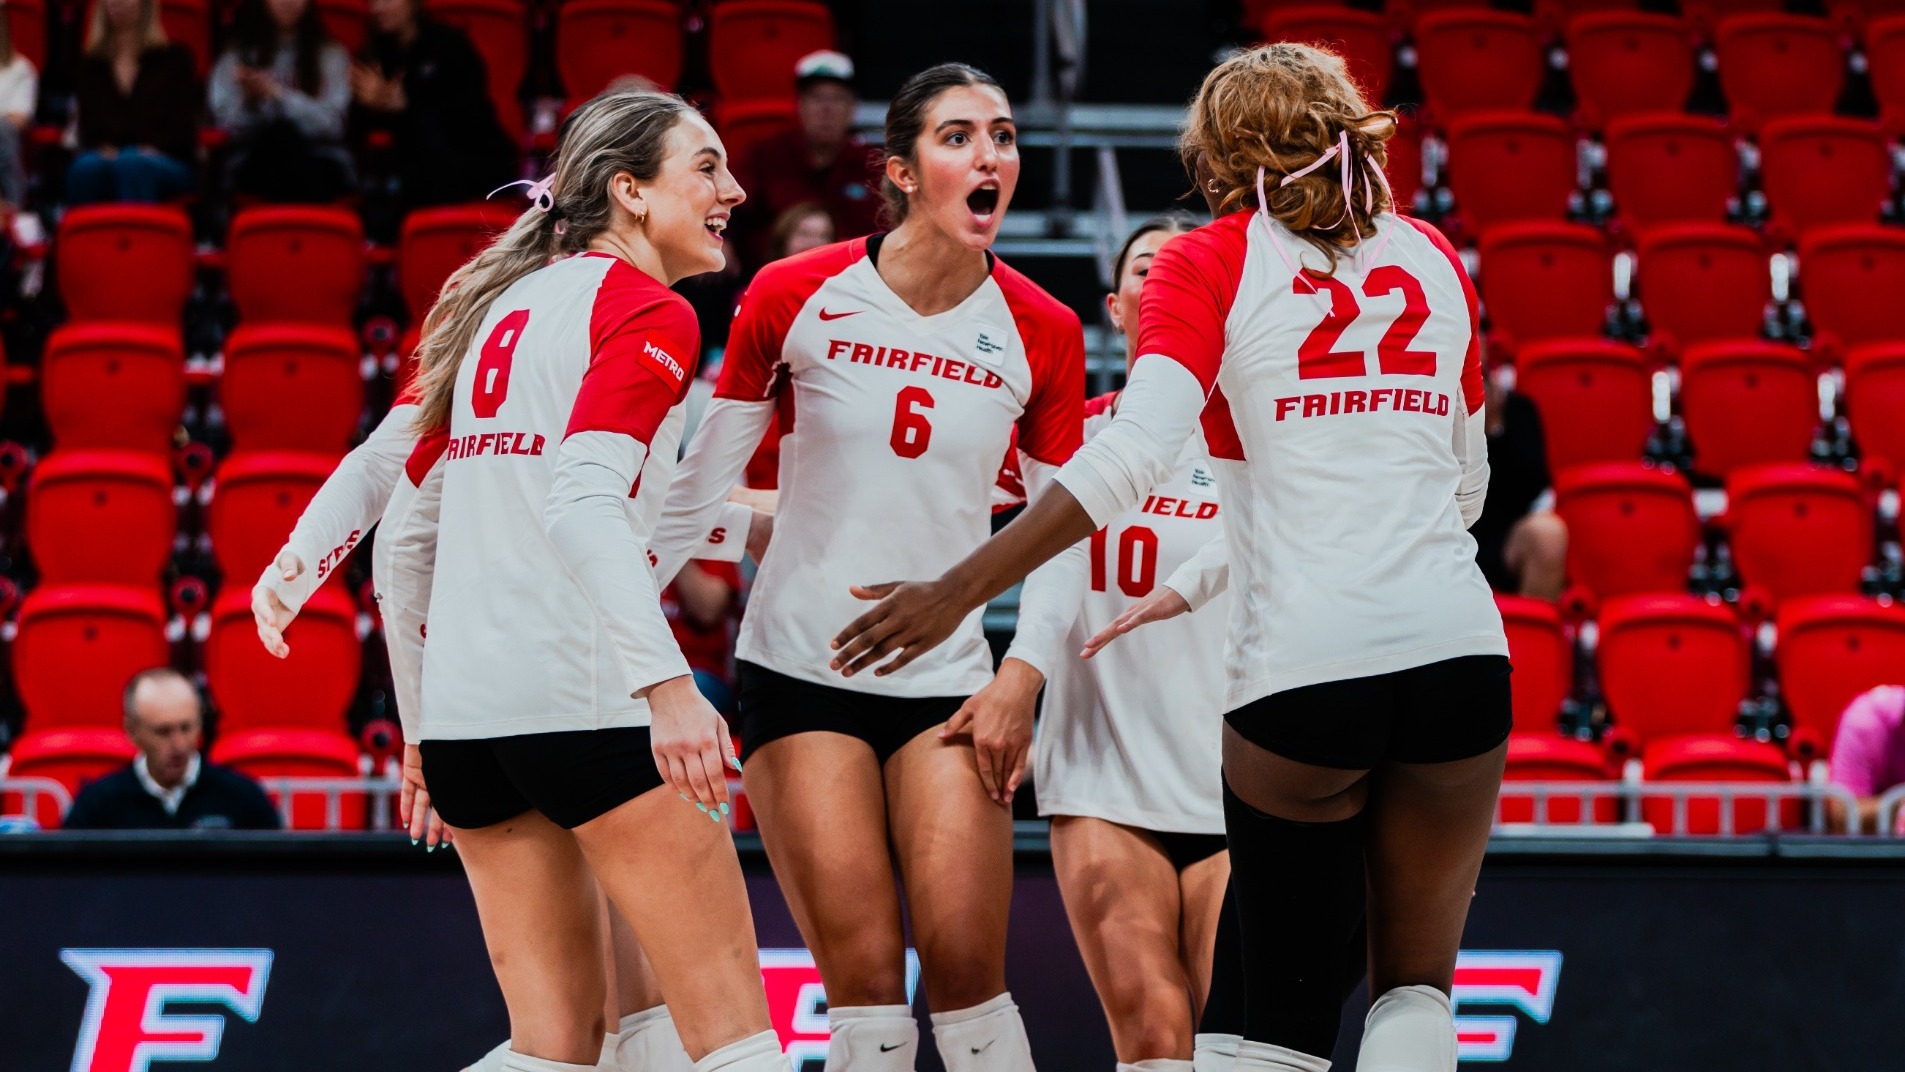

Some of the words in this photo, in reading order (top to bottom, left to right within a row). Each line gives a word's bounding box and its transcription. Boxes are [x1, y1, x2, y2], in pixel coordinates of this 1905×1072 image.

[1292, 264, 1437, 381] 22
[471, 308, 530, 419] 8
[643, 340, 685, 382] METRO
[827, 339, 1003, 389] FAIRFIELD
[889, 385, 935, 459] 6
[1273, 388, 1449, 422] FAIRFIELD
[446, 431, 546, 461] AIRFIELD
[1089, 523, 1159, 598] 10
[58, 947, 274, 1072] F
